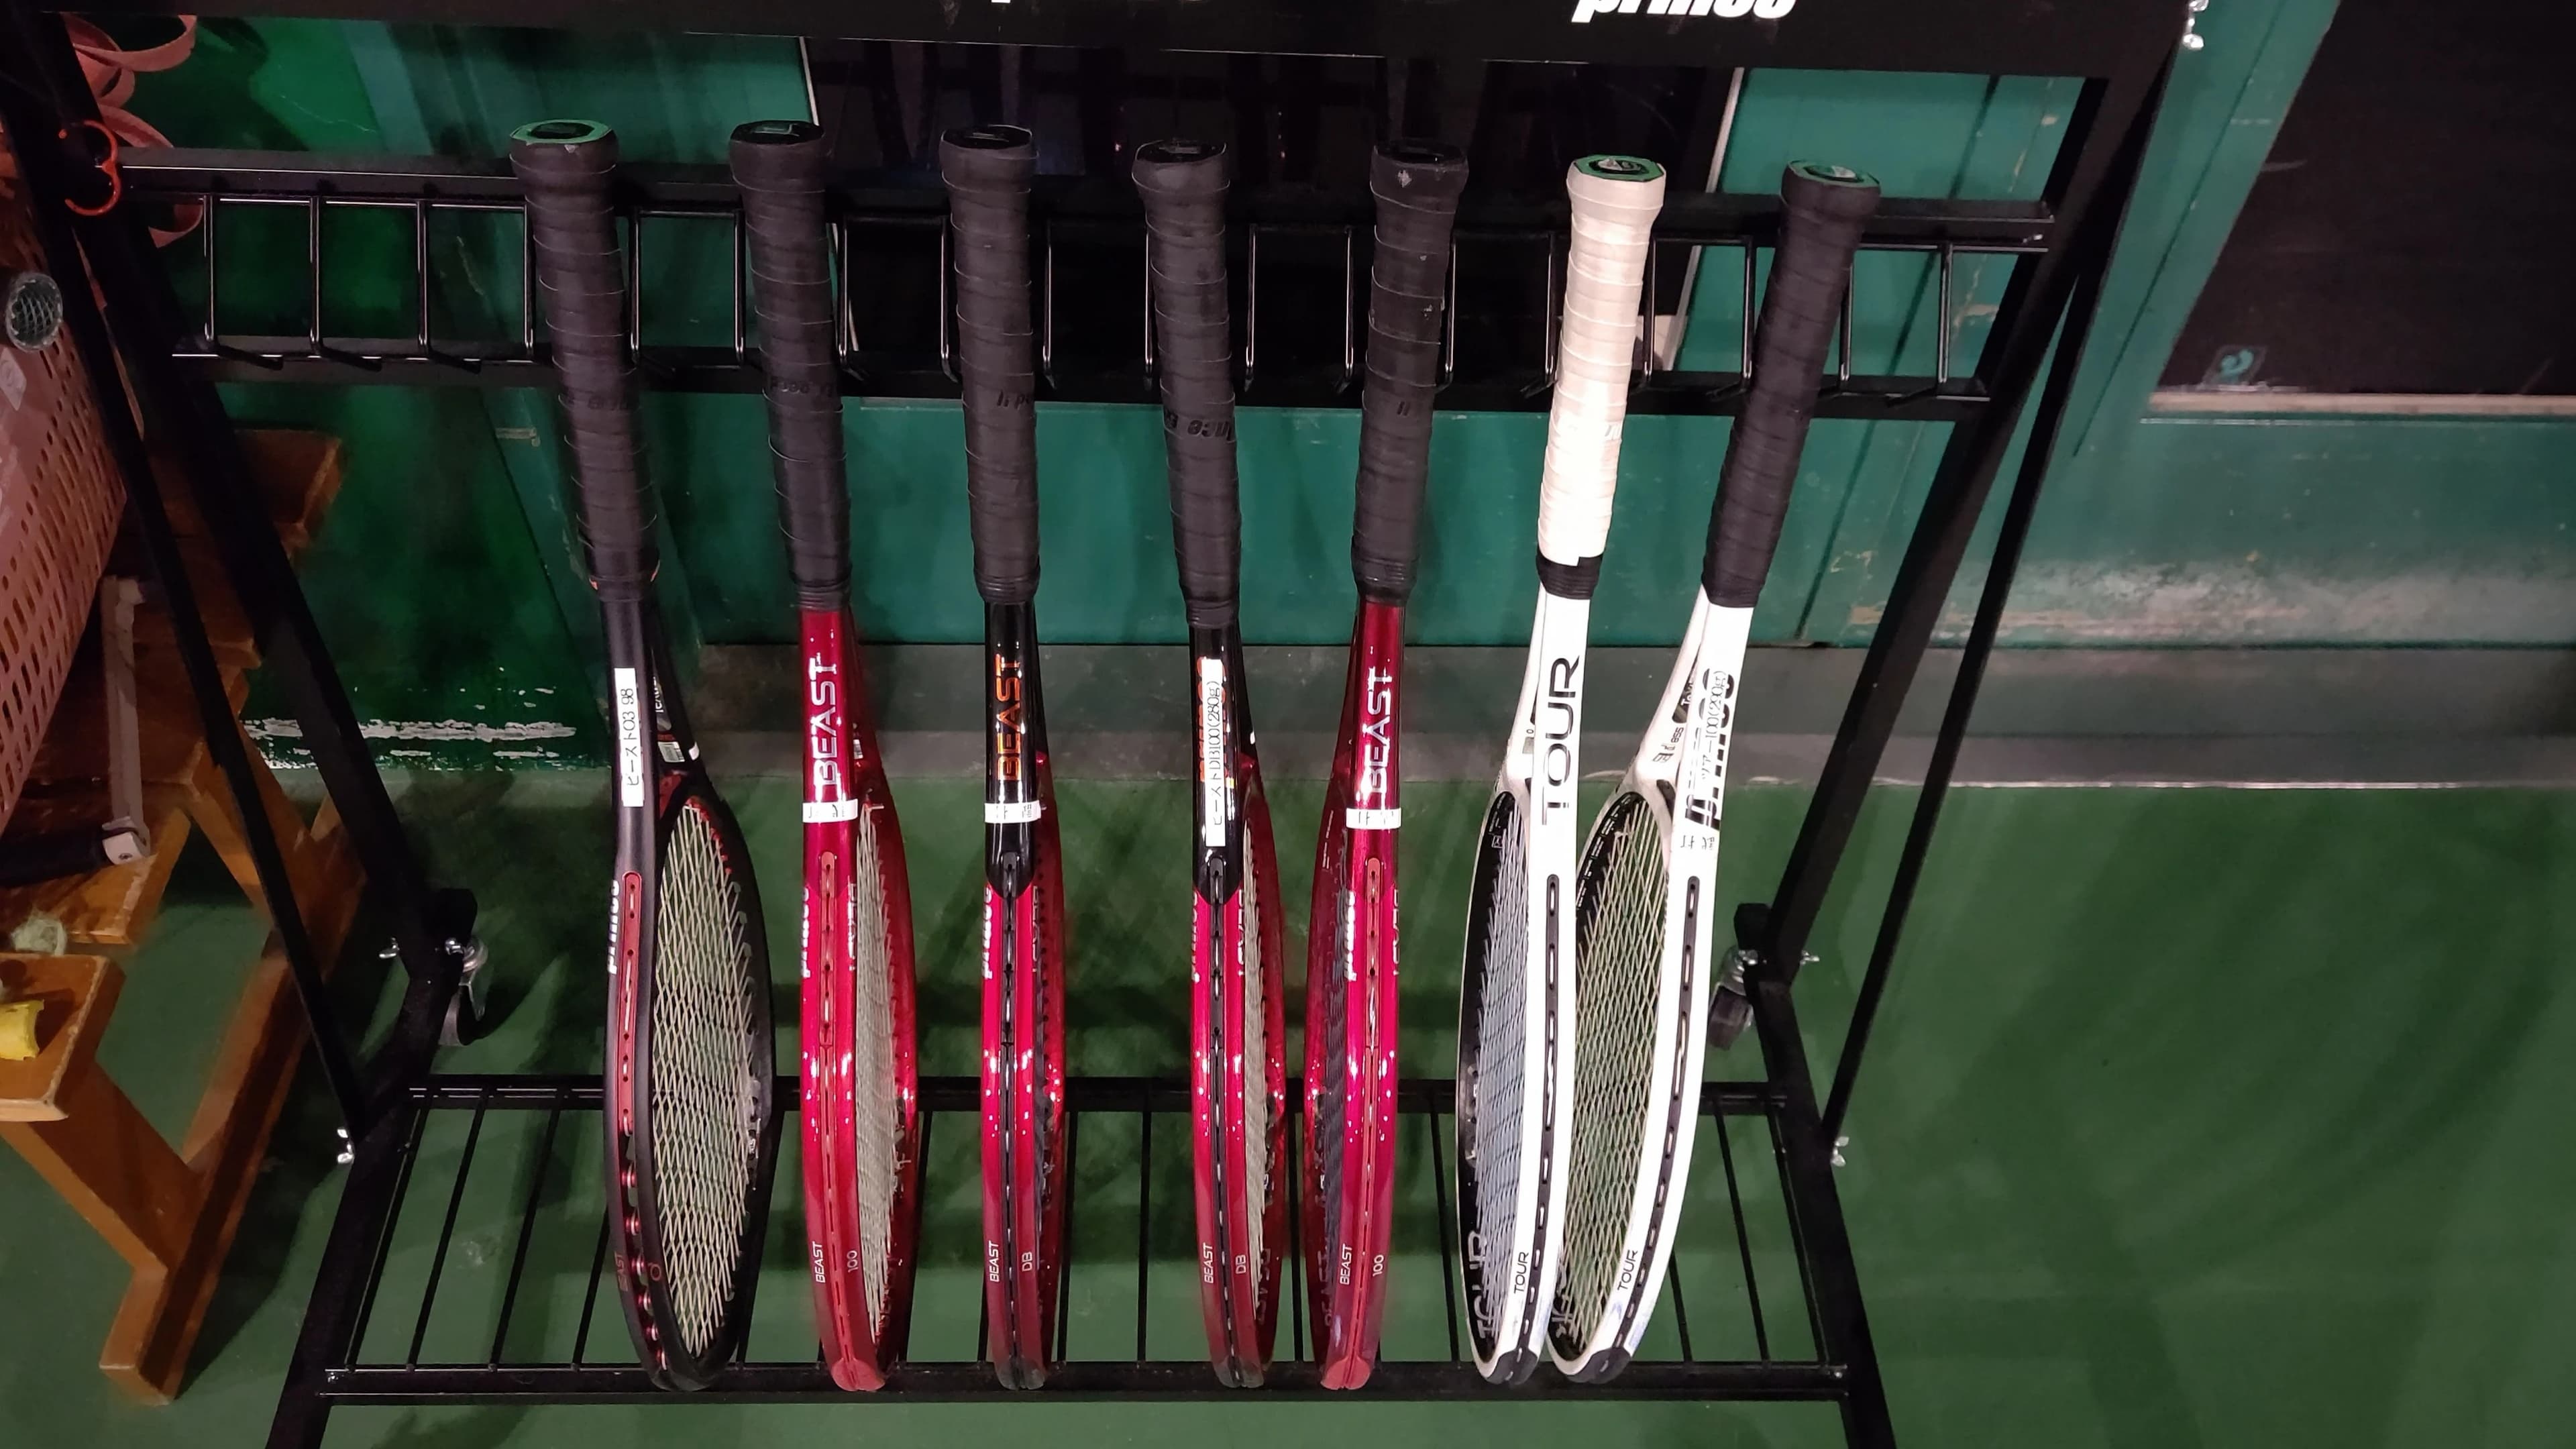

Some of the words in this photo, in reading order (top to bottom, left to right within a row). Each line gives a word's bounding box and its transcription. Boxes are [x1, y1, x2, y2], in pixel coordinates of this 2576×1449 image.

[620, 688, 634, 704] 98
[996, 654, 1022, 781] BEAST
[809, 656, 837, 785] BEAST
[1362, 666, 1393, 794] BEAST
[1542, 655, 1580, 826] TOUR
[812, 1241, 826, 1283] BEAST
[847, 1250, 859, 1273] 100
[989, 1240, 1000, 1283] BEAST
[1022, 1251, 1034, 1272] DB
[1203, 1242, 1214, 1284] BEAST
[1235, 1254, 1247, 1275] DB
[1339, 1243, 1353, 1285] BEAST
[1373, 1254, 1385, 1277] 100
[1513, 1251, 1529, 1295] TOUR
[1617, 1248, 1638, 1291] TOUR
